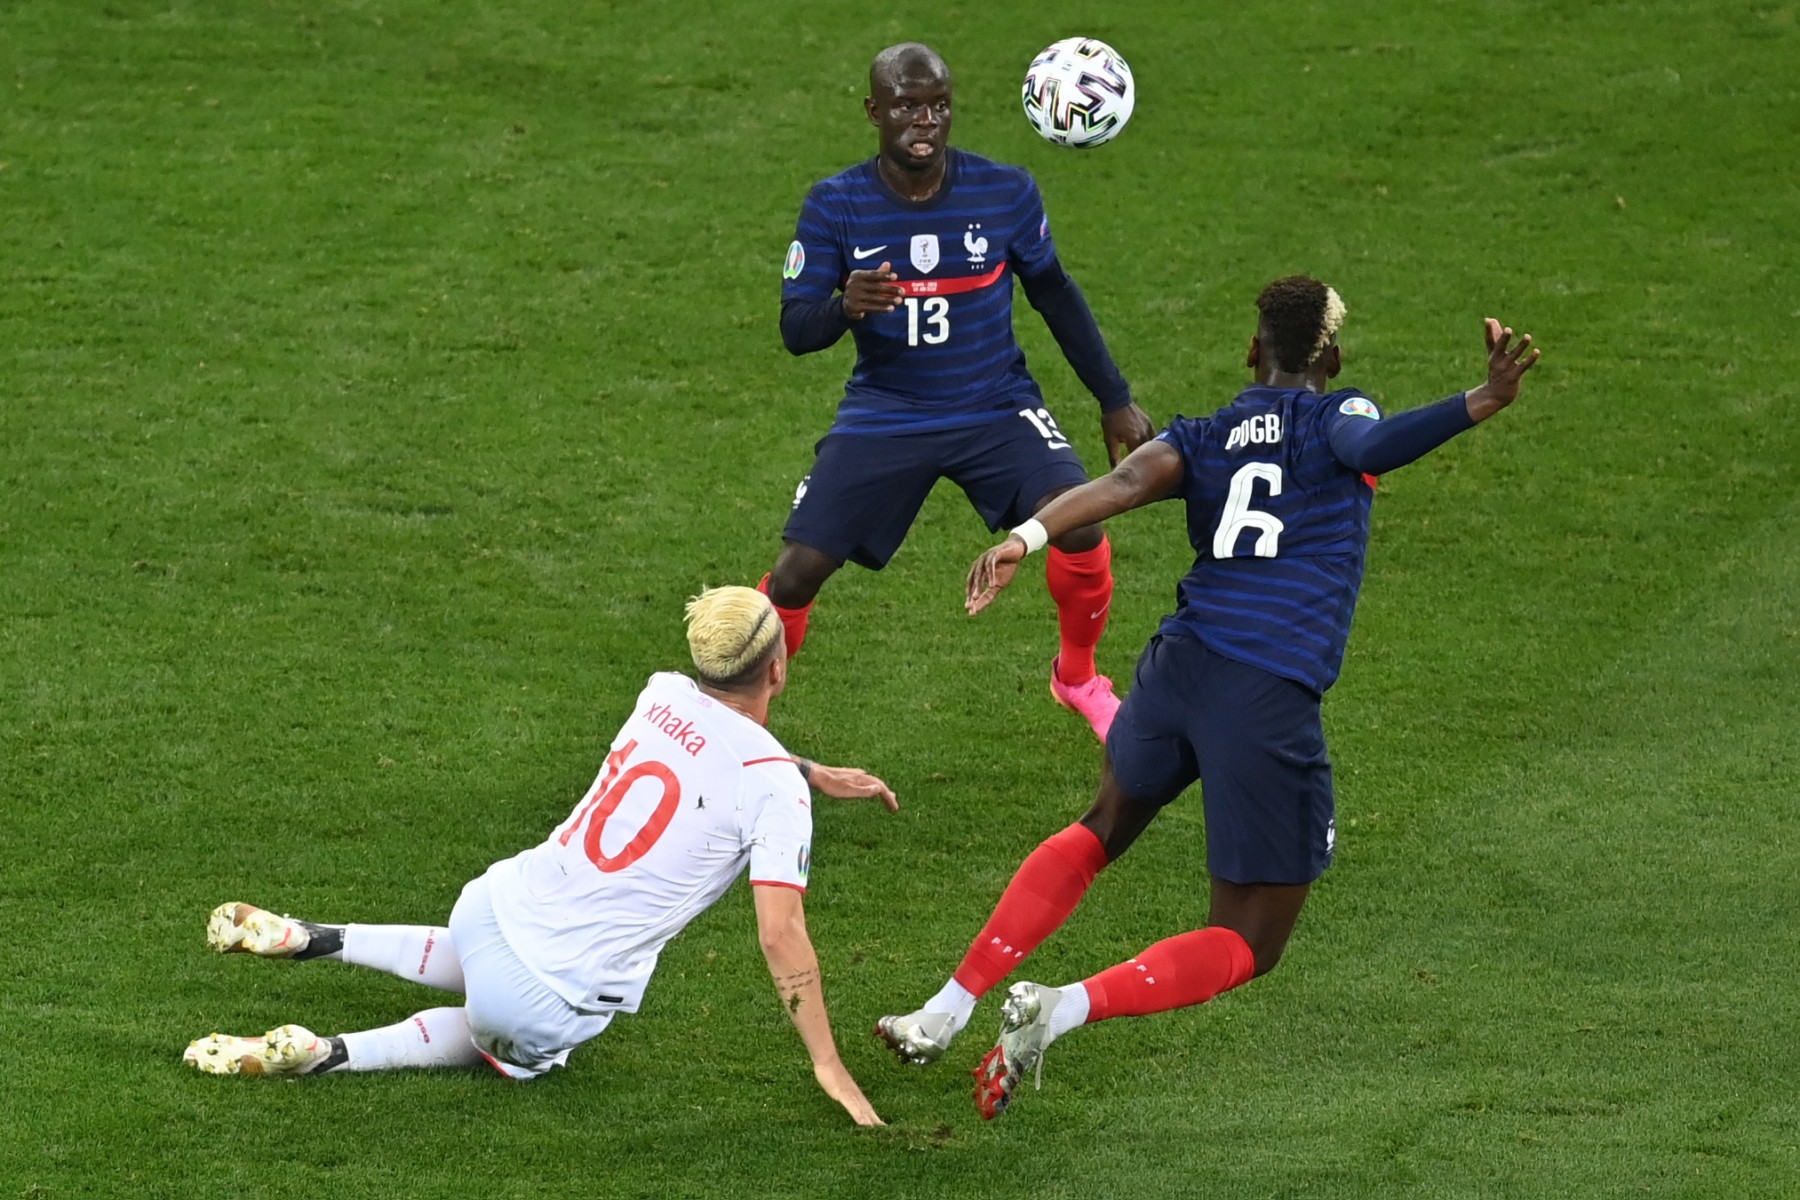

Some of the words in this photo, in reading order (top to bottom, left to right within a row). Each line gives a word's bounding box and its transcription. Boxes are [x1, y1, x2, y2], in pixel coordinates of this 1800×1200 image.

[904, 297, 950, 346] 13
[1018, 408, 1067, 441] 13
[1225, 413, 1284, 450] POGB
[1213, 462, 1284, 559] 6
[643, 702, 706, 757] xhaka
[558, 738, 681, 873] 10
